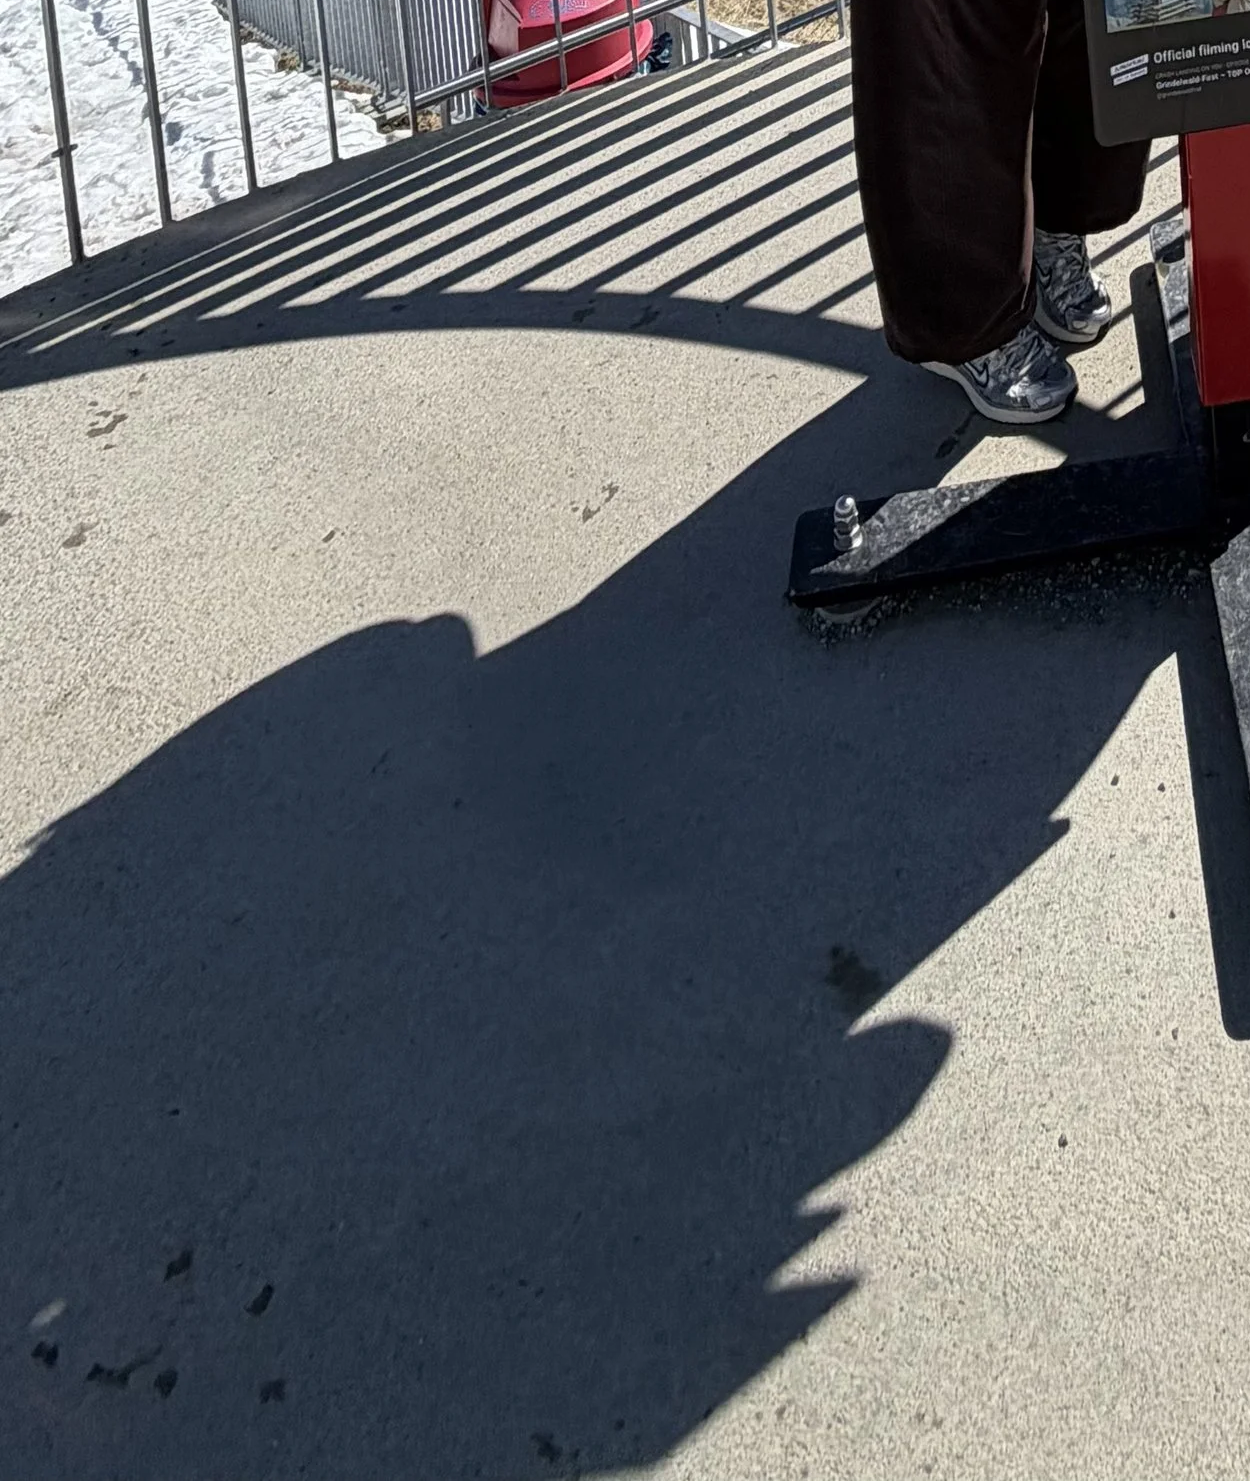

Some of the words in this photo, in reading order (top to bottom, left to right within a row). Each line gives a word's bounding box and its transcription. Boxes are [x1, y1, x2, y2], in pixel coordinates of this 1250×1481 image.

[1153, 46, 1196, 64] Official
[1199, 40, 1239, 57] filming
[1227, 68, 1243, 78] TOP
